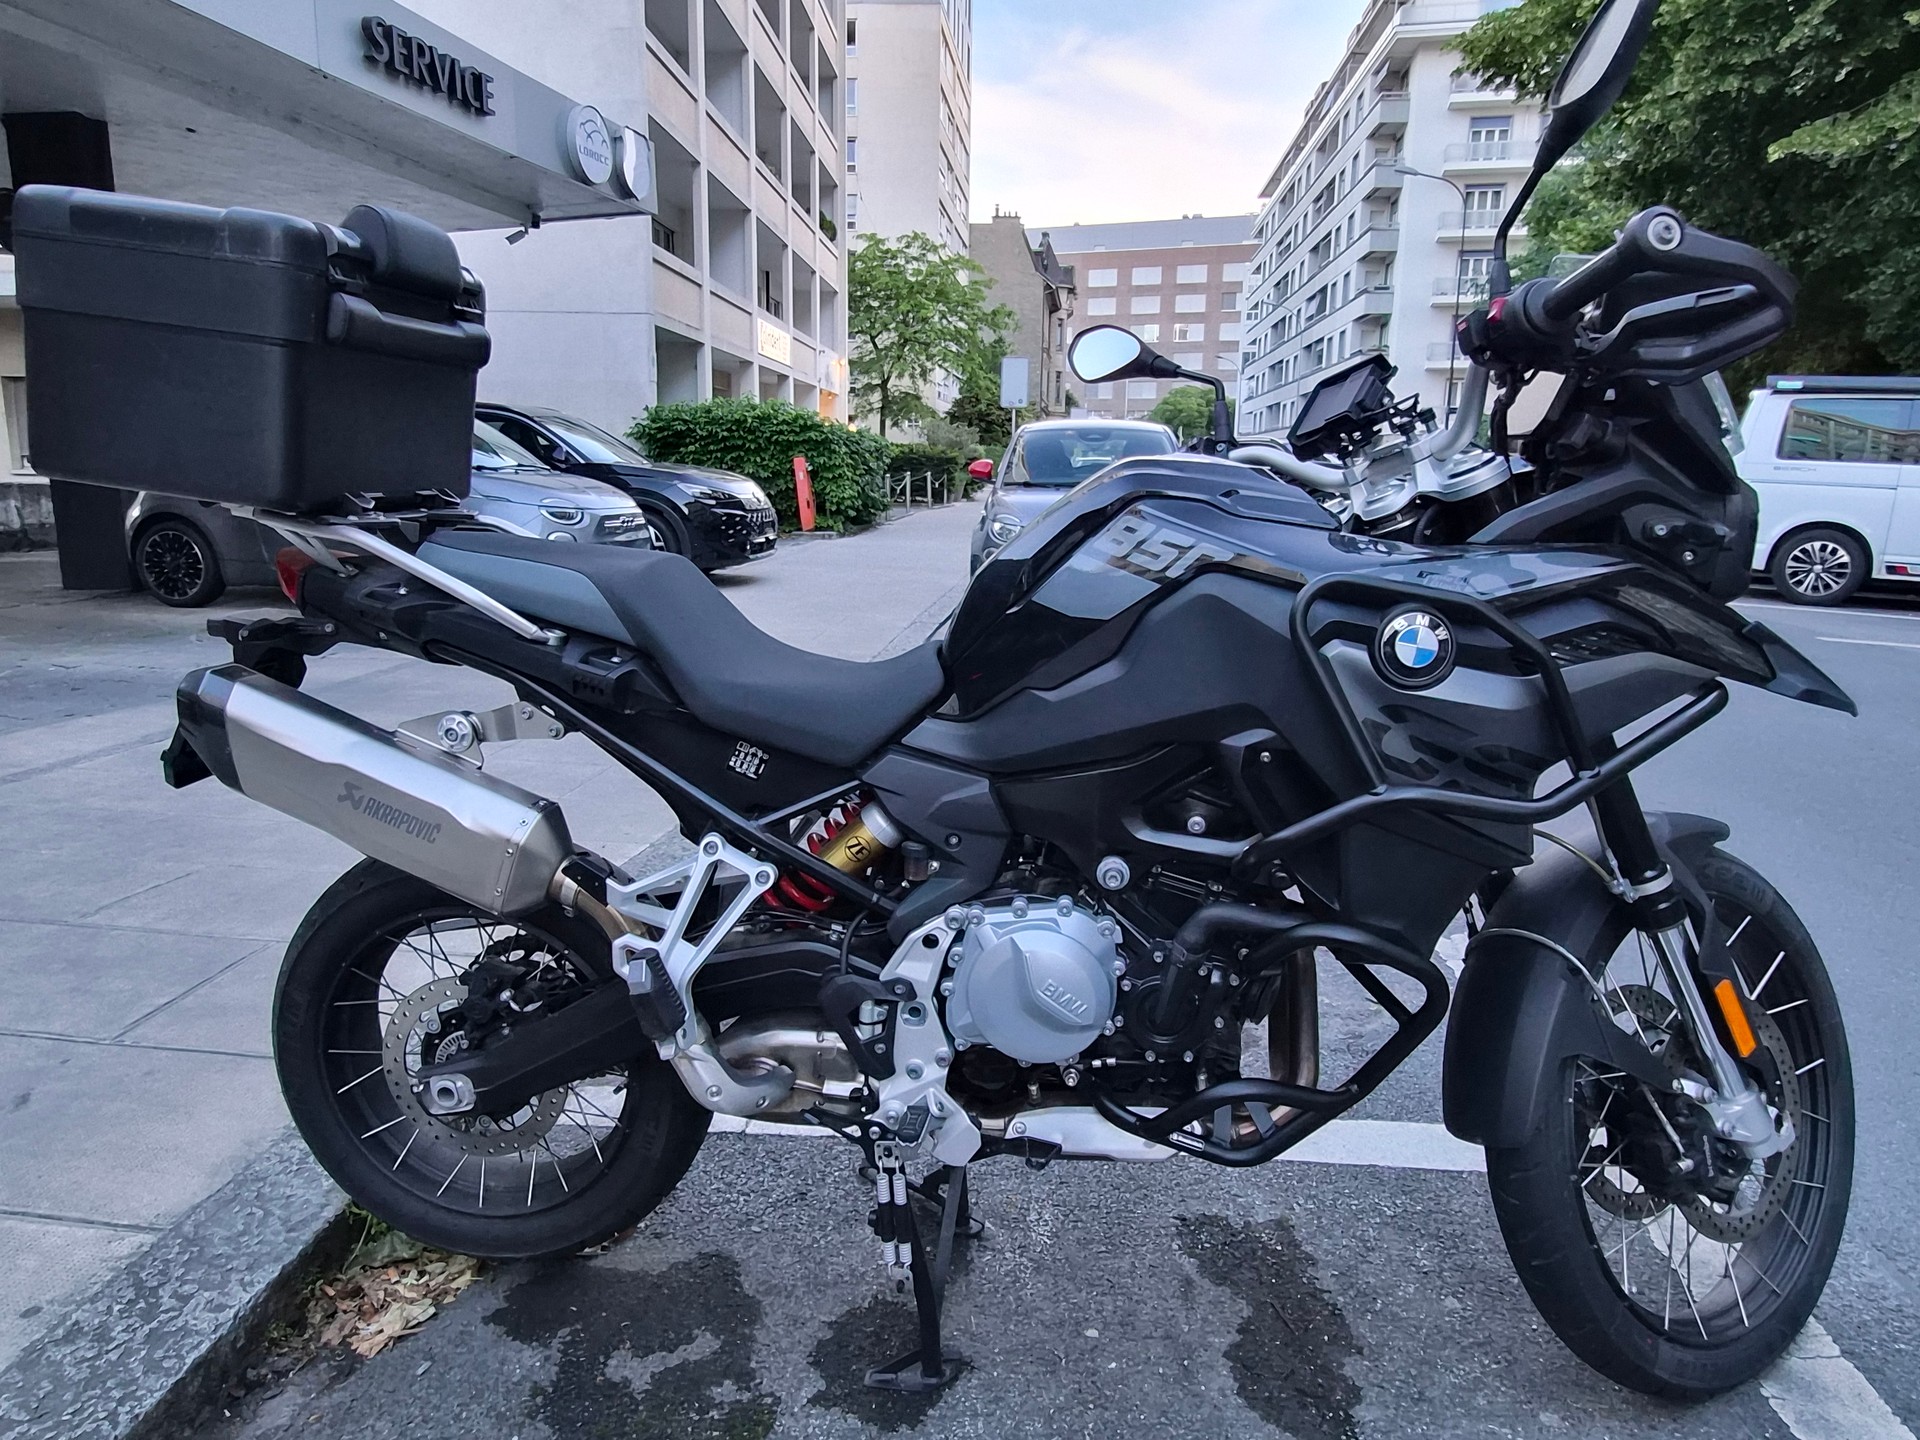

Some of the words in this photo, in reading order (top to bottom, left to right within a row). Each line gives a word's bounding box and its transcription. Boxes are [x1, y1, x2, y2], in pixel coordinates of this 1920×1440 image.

[361, 16, 496, 117] SERVICE
[1393, 614, 1449, 641] BMW
[847, 836, 870, 860] ZF
[1041, 979, 1088, 1015] BMW
